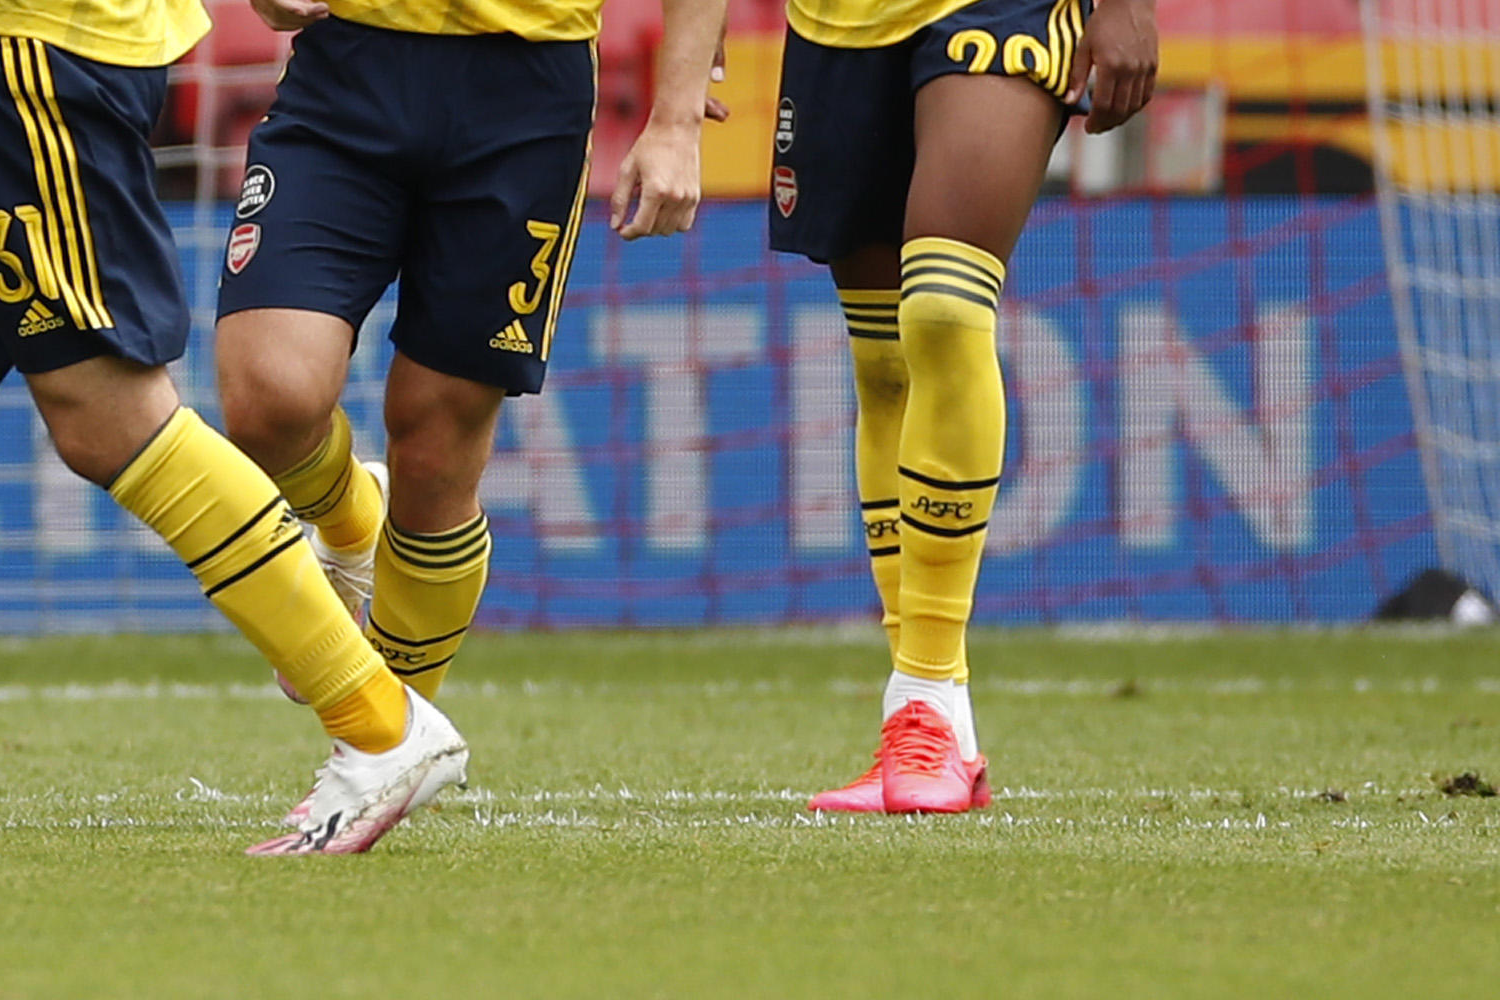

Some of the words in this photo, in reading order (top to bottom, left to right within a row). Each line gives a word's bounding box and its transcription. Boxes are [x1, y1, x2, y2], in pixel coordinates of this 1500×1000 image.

[508, 219, 561, 315] 3
[17, 315, 65, 338] adidas
[488, 337, 533, 354] adidas
